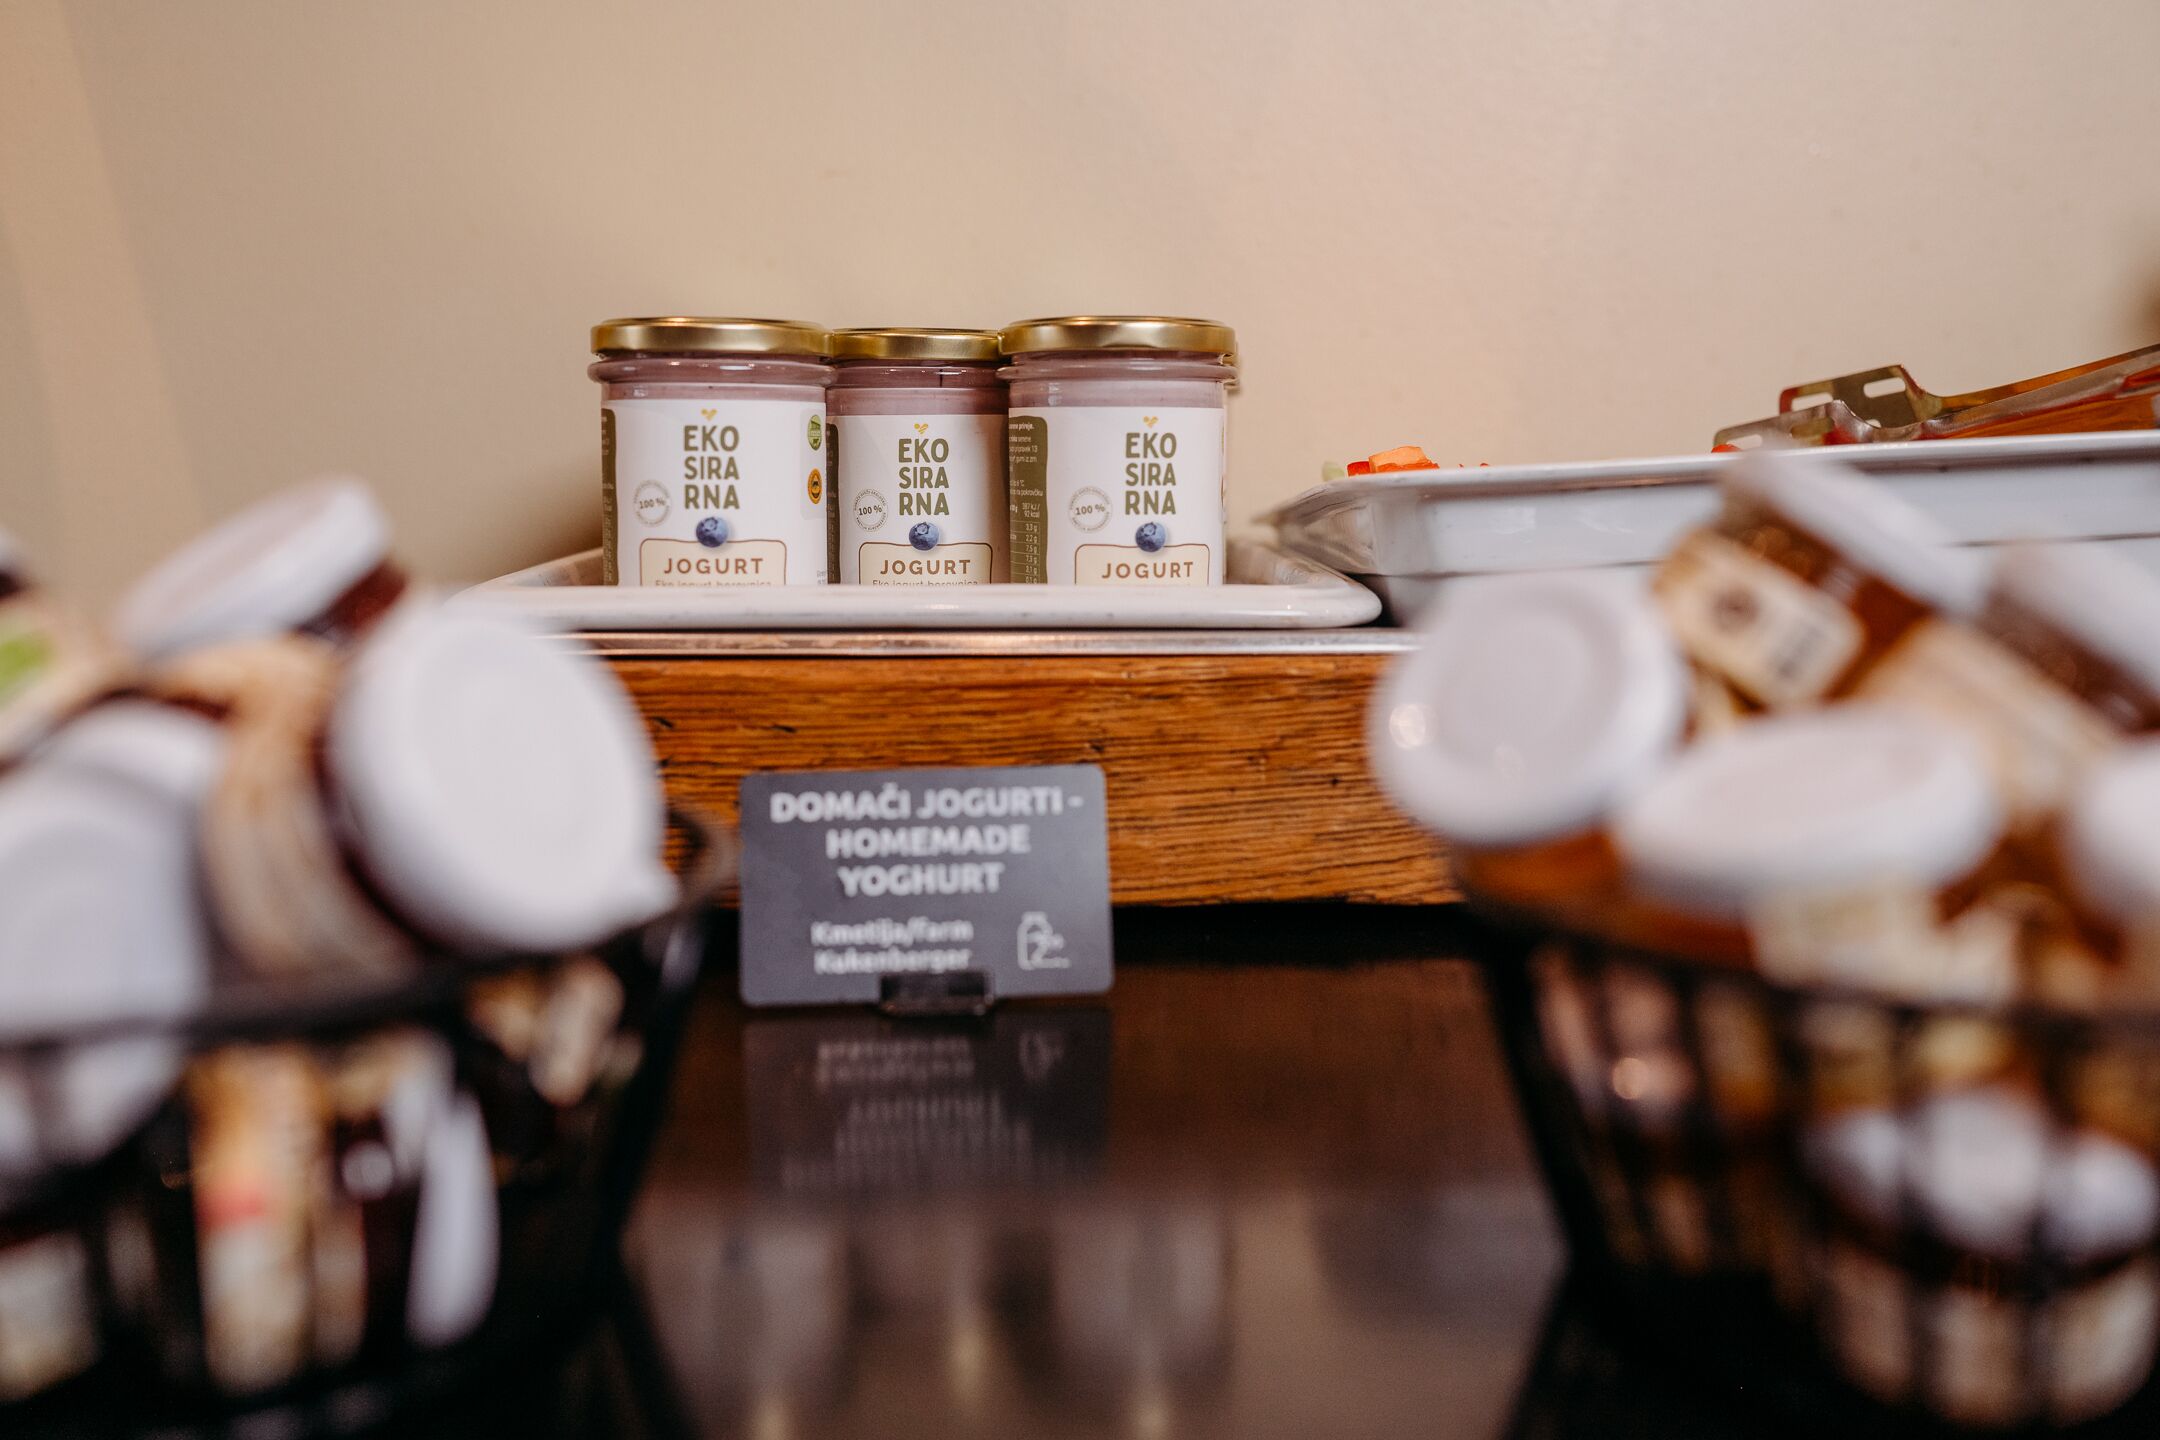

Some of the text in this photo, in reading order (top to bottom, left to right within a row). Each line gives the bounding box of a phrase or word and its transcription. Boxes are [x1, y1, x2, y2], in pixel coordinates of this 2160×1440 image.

[684, 425, 740, 452] EKO
[898, 438, 950, 463] EKO
[1125, 432, 1177, 459] EKO
[684, 456, 740, 480] SIRA
[898, 466, 950, 489] SIRA
[1125, 462, 1176, 486] SIRA
[639, 498, 653, 509] 100
[684, 484, 740, 509] RNA
[898, 492, 950, 516] RNA
[1125, 490, 1176, 515] RNA
[858, 504, 883, 516] 100 %
[1075, 503, 1106, 516] 100 %
[664, 558, 764, 574] JOGURT
[880, 559, 971, 575] JOGURT
[1101, 561, 1194, 579] JOGURT
[769, 781, 912, 824] DOMAČI
[915, 785, 1064, 819] JOGURTI
[825, 823, 1031, 860] HOMEMADE
[837, 861, 1006, 898] YOGHURT
[810, 915, 975, 948] Kmetija/farm
